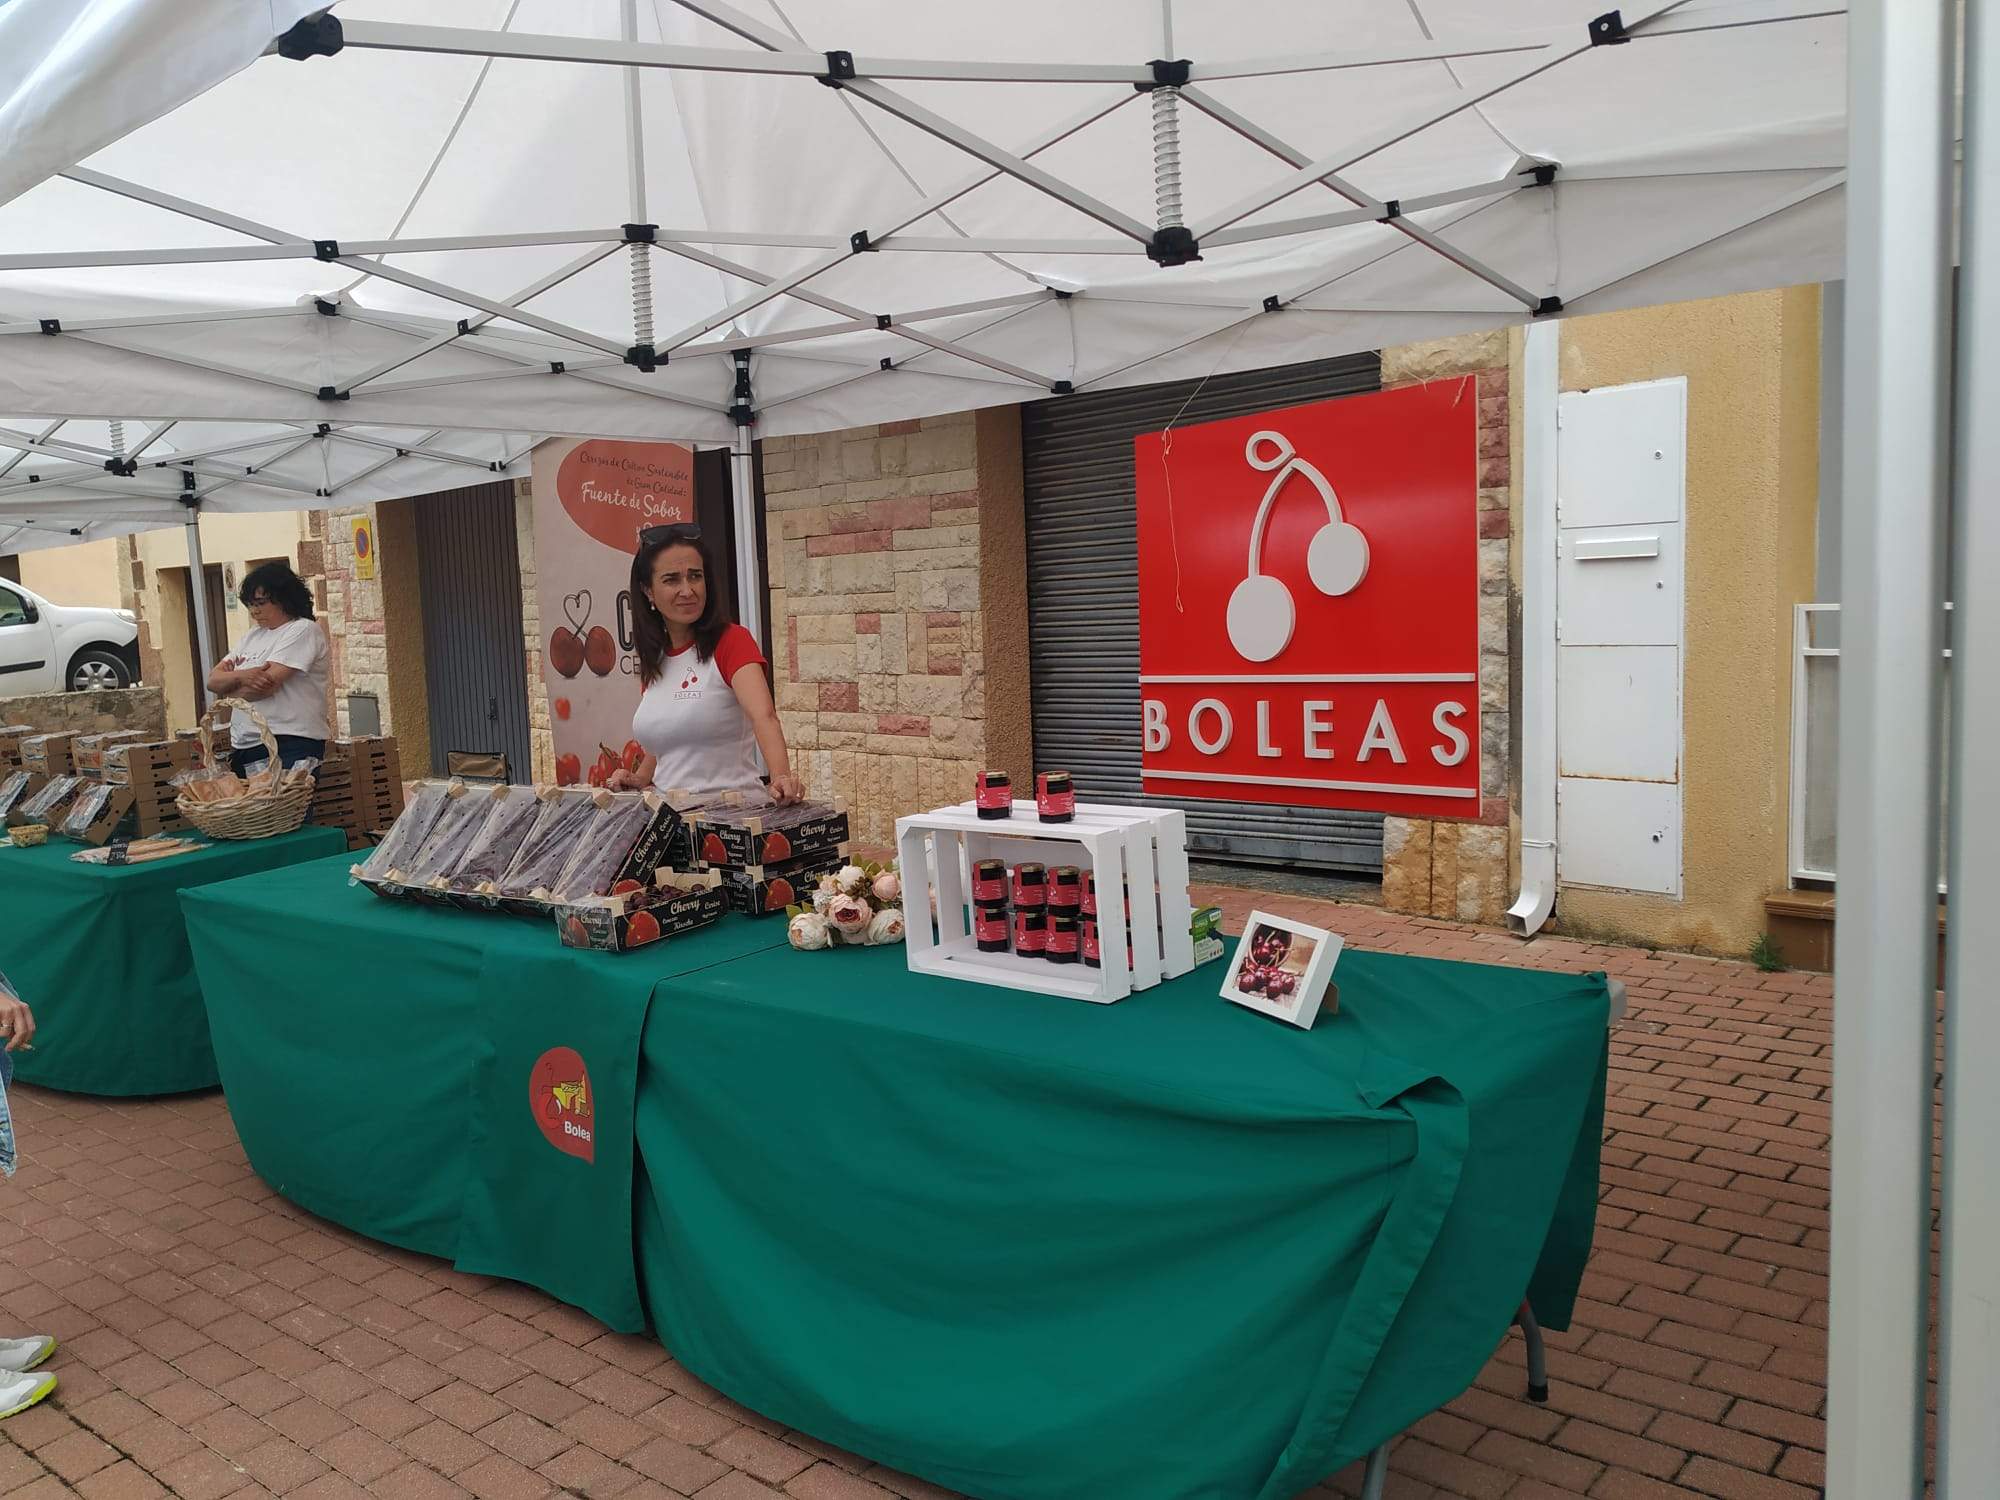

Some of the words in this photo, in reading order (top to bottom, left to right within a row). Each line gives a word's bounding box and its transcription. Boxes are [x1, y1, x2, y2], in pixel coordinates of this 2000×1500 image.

[581, 480, 627, 507] Fuente
[629, 493, 641, 510] de
[643, 494, 681, 520] Sabor
[1144, 698, 1469, 766] BOLEAS
[719, 830, 741, 844] Cherry
[800, 824, 826, 837] Cherry
[634, 831, 658, 863] Cherry
[670, 899, 700, 915] Cherry
[564, 1120, 591, 1142] Bolea
